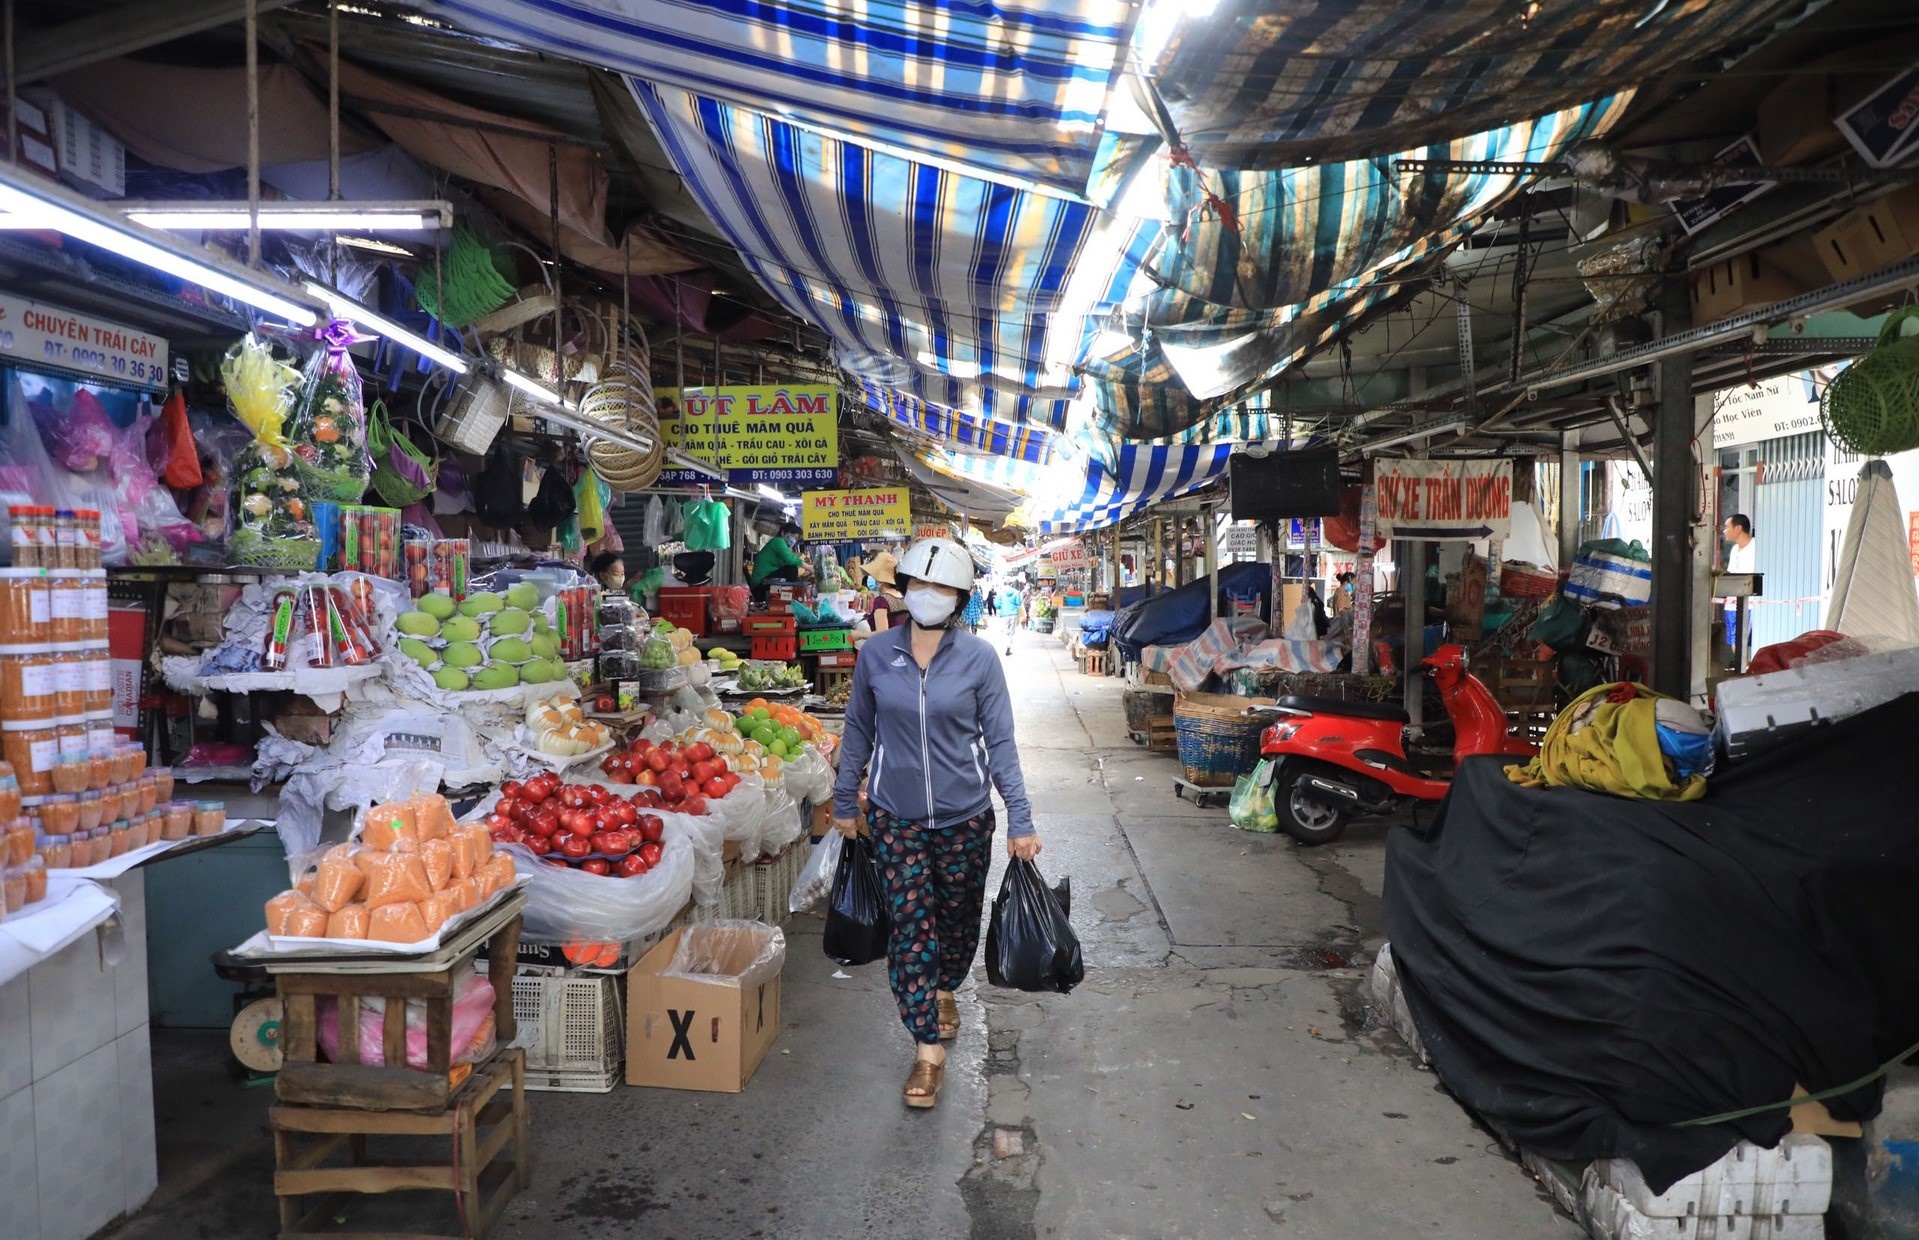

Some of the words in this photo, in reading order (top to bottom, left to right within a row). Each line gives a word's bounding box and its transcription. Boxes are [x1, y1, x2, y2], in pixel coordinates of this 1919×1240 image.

[23, 310, 89, 342] CHUYÊN
[94, 328, 127, 351] TRÁI
[130, 336, 157, 358] CÂY
[111, 355, 126, 374] 30
[130, 361, 145, 378] 36
[149, 365, 164, 382] 30
[747, 388, 831, 416] LÂM
[1745, 390, 1765, 402] Nam
[1723, 413, 1740, 424] Học
[746, 422, 782, 434] MÂM
[785, 418, 815, 434] QUẢ
[765, 440, 785, 449] CAU
[795, 438, 812, 449] XÔI
[807, 453, 827, 464] CÂY
[679, 470, 696, 480] 768
[769, 470, 793, 480] 0903
[795, 469, 813, 479] 303
[815, 469, 833, 479] 630
[815, 494, 837, 508] MỸ
[842, 493, 899, 507] THANH
[1401, 477, 1420, 520] XE
[828, 510, 840, 518] CHO
[869, 518, 880, 527] CAU
[1070, 550, 1083, 560] XE
[125, 671, 133, 716] CANADIAN
[666, 1009, 696, 1061] X
